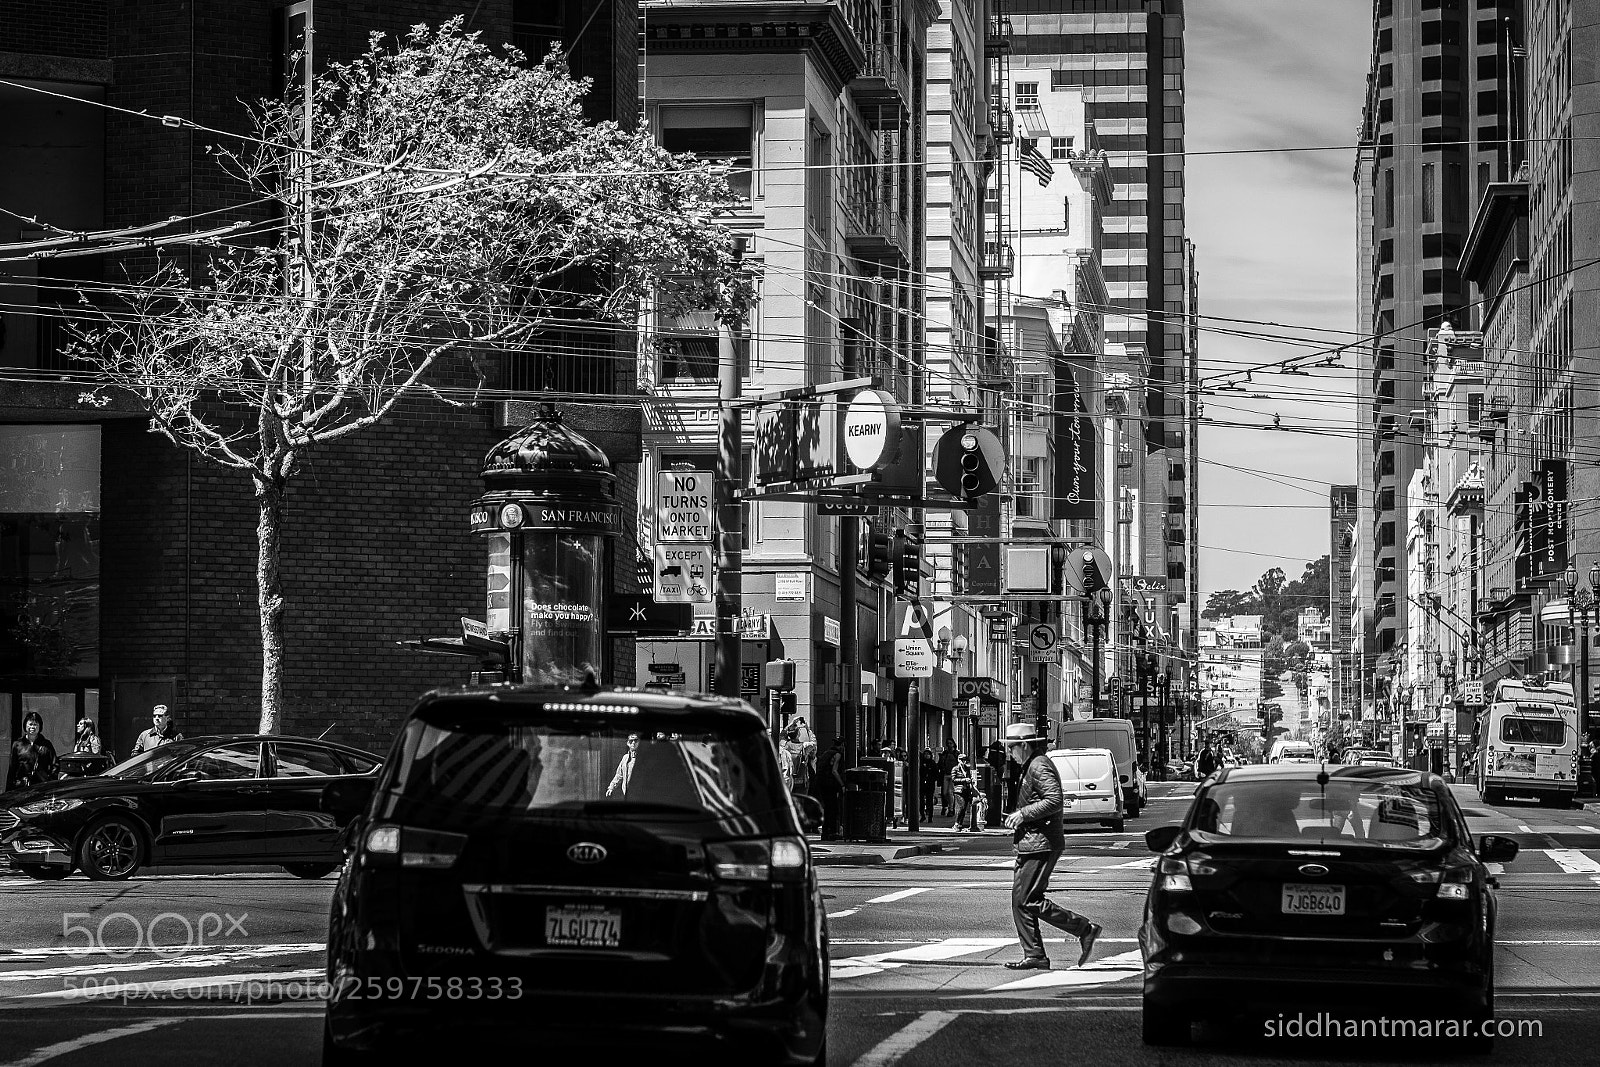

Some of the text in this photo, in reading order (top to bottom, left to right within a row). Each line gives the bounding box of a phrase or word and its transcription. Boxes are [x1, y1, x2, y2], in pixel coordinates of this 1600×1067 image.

[848, 423, 882, 437] KEARNY
[1072, 441, 1087, 474] your
[674, 476, 696, 492] NO
[1066, 475, 1080, 505] Own
[662, 495, 708, 509] TURNS
[541, 509, 619, 524] SAN FRANCISCO
[669, 512, 700, 523] ONTO
[662, 525, 709, 537] MARKET
[665, 550, 703, 560] EXCEPT
[1547, 538, 1555, 562] POST
[662, 586, 679, 594] TAXI
[531, 602, 589, 612] Does chocolate
[531, 619, 543, 628] Fly
[554, 613, 570, 621] you
[570, 613, 594, 621] happy?
[548, 629, 564, 637] find
[959, 681, 990, 695] TOYS
[1466, 693, 1482, 703] 25
[572, 846, 601, 861] KIA
[1286, 894, 1342, 911] 7JGB640
[548, 917, 619, 941] 7LGU774
[415, 943, 476, 957] SEDONA
